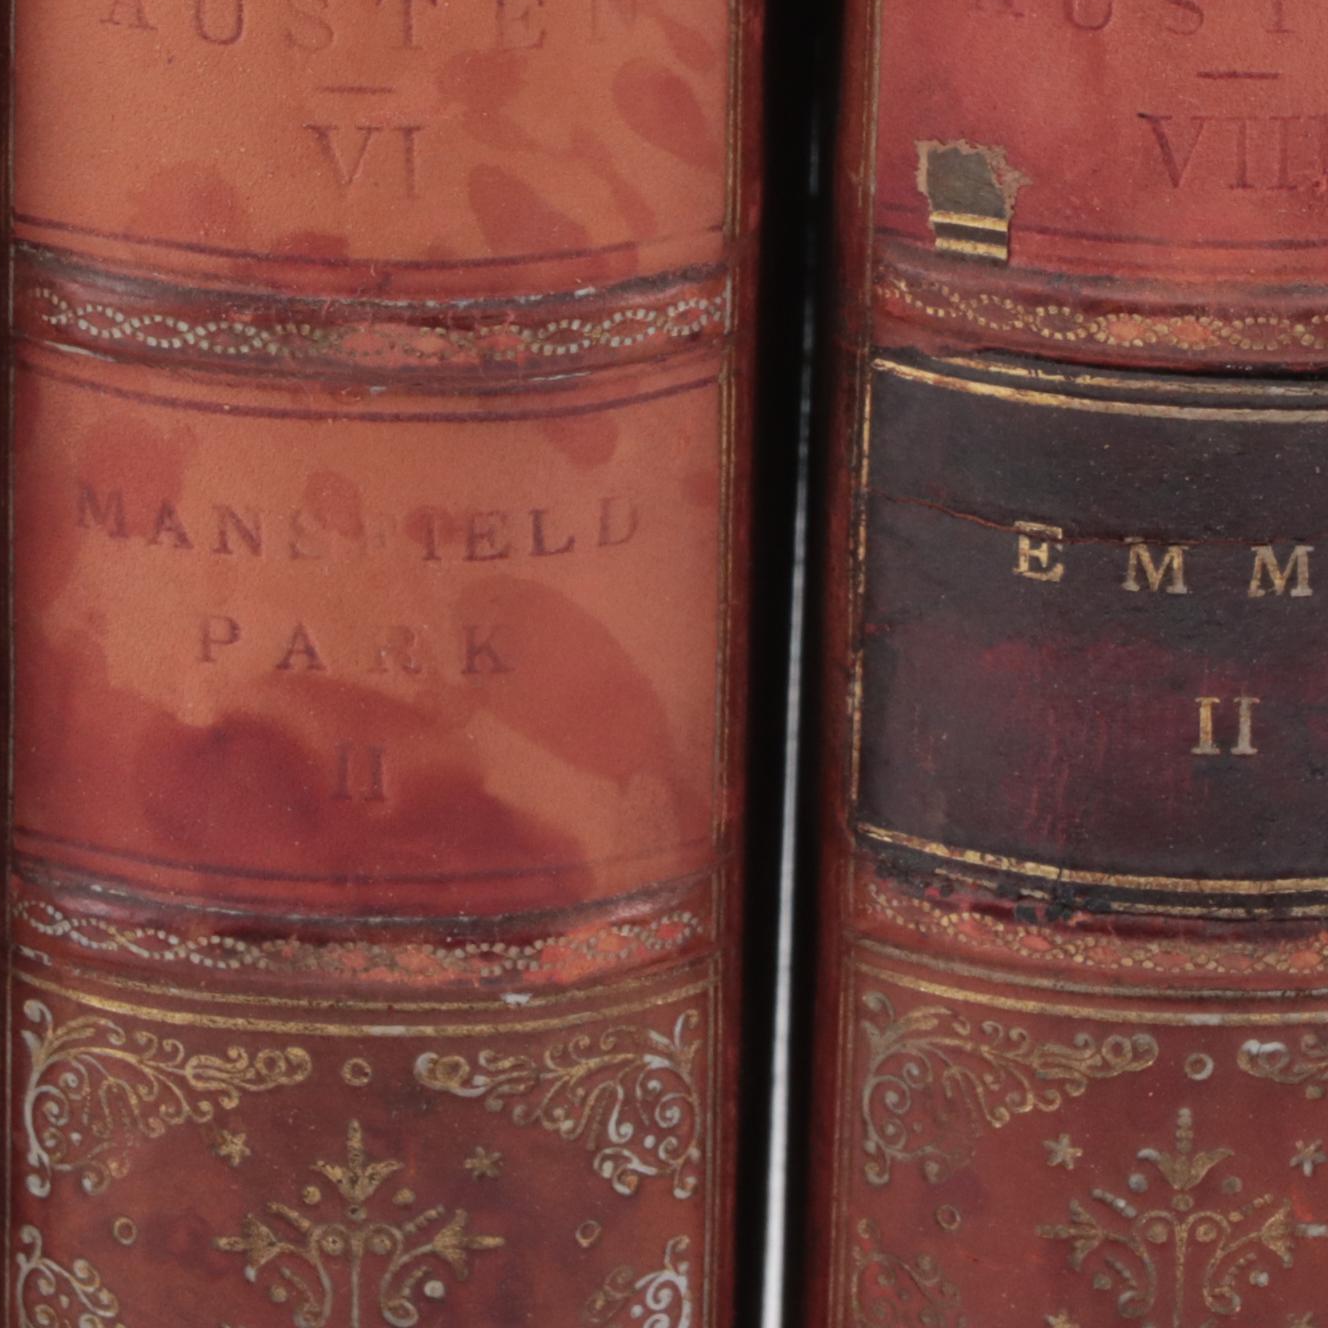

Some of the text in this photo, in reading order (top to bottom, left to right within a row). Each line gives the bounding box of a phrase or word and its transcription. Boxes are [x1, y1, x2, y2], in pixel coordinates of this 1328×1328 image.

[302, 122, 426, 200] VI
[195, 614, 516, 676] PARK
[1188, 695, 1260, 757] II
[330, 738, 386, 802] II
